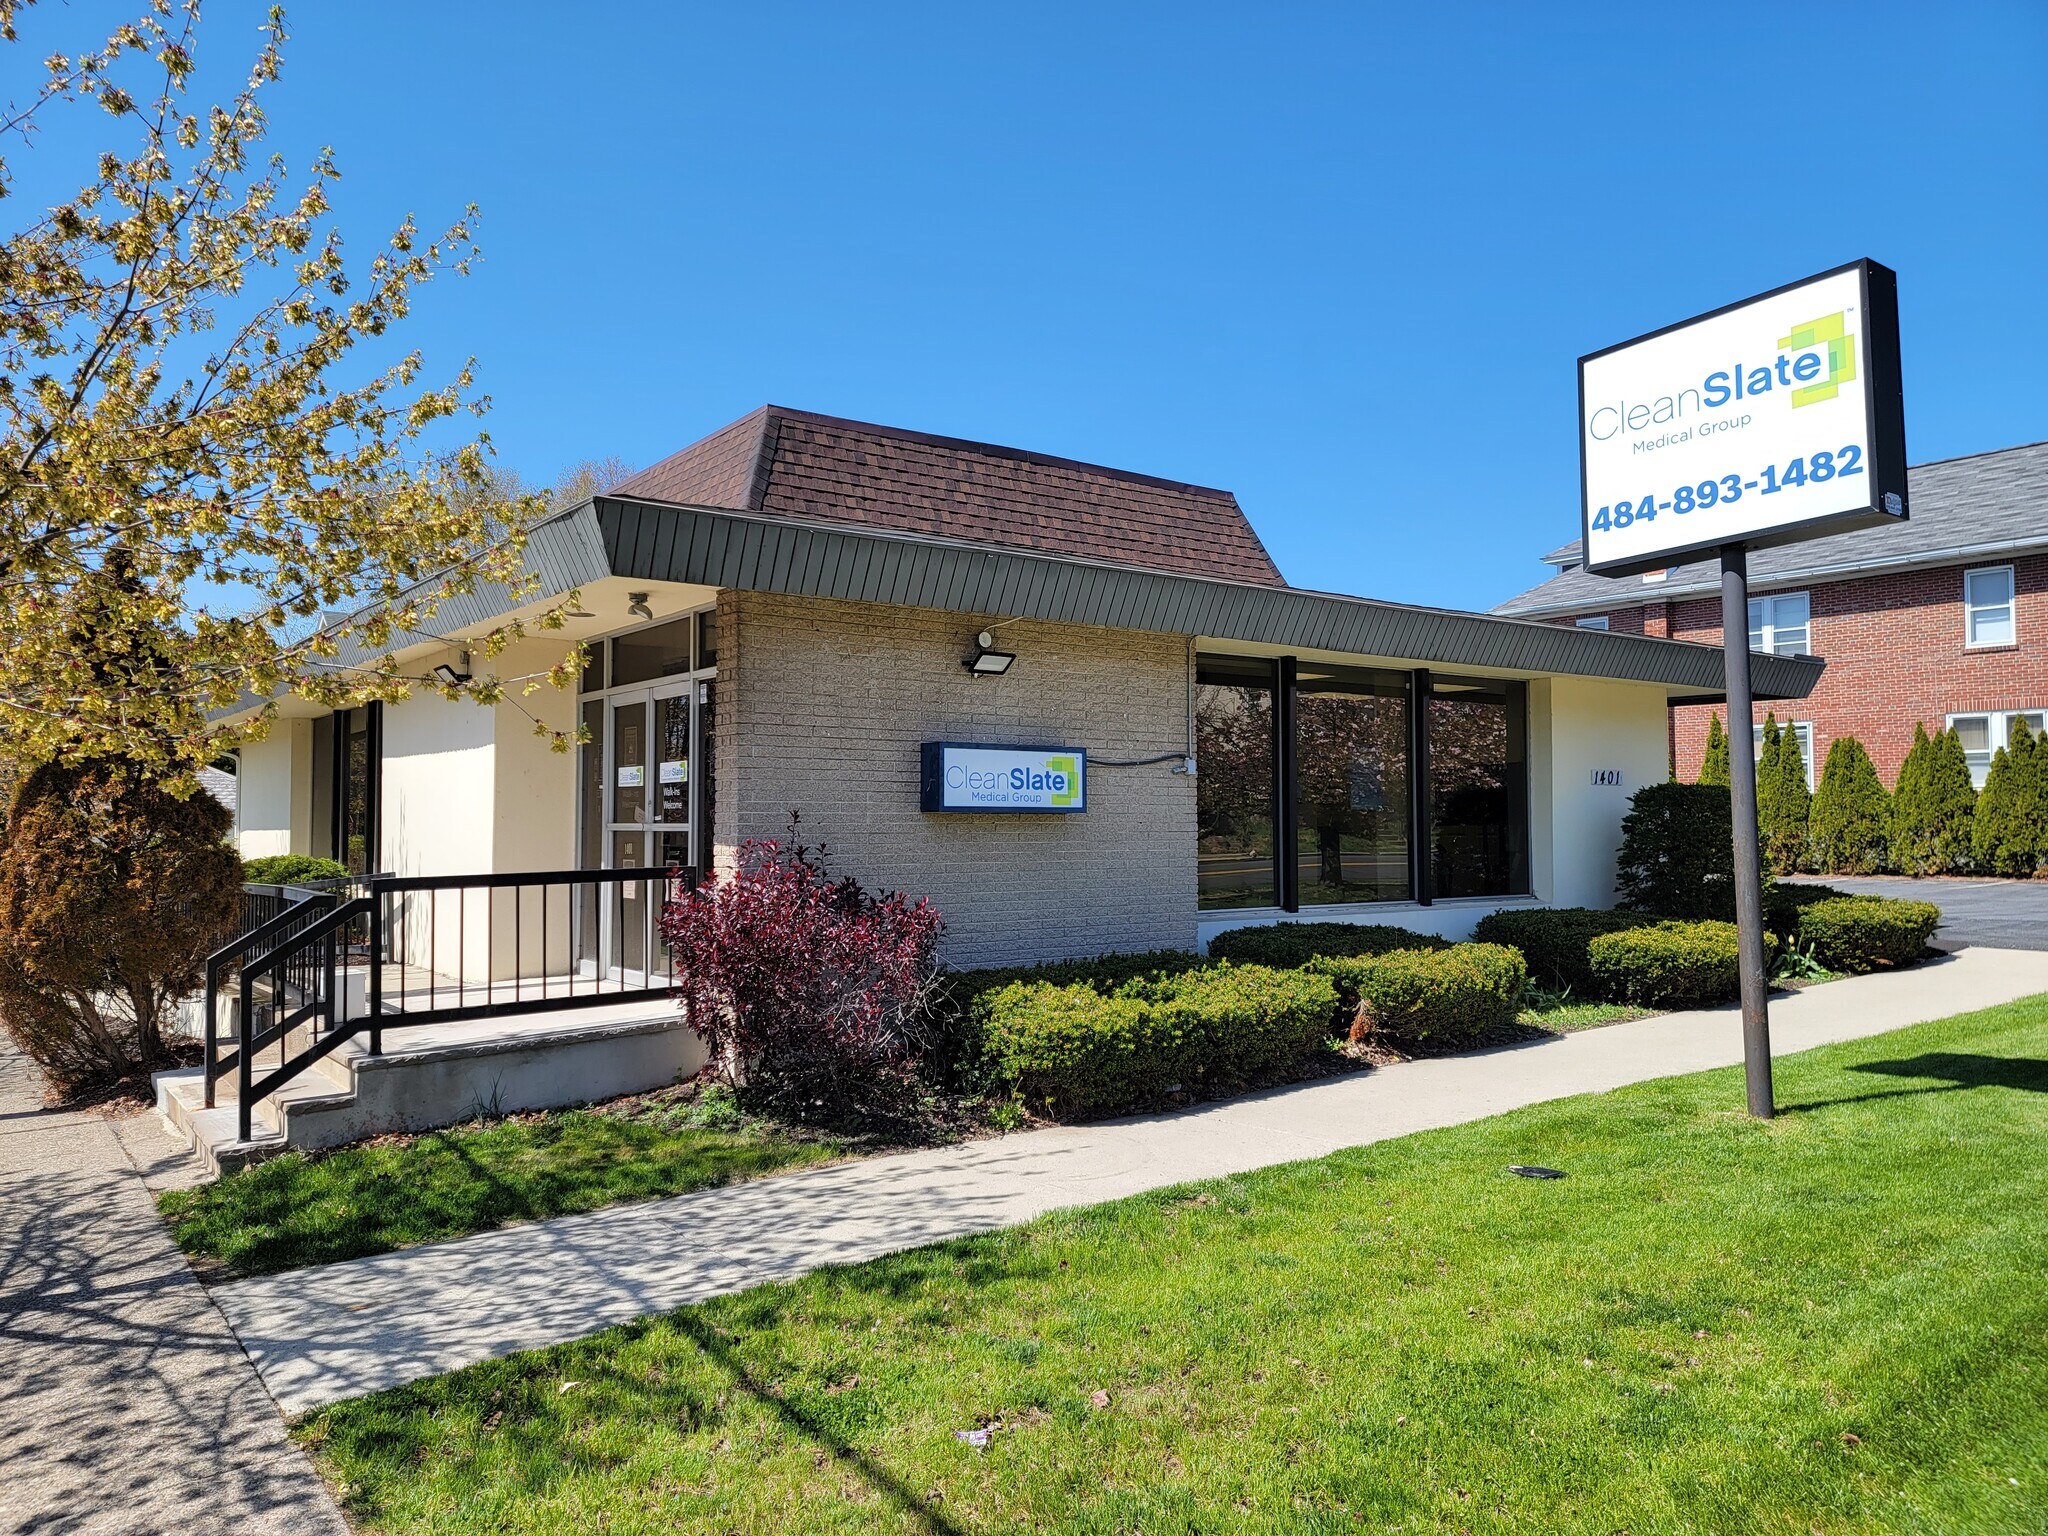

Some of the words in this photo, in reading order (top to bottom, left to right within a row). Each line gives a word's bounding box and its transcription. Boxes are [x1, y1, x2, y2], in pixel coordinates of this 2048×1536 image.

[1590, 351, 1821, 441] CleanSlate
[1632, 427, 1693, 455] Medical
[1699, 413, 1752, 437] Group
[1591, 445, 1864, 533] 484-893-1482
[946, 765, 1065, 791] CleanSlate
[1594, 770, 1620, 785] 1401
[663, 800, 683, 810] Welcome
[971, 792, 1009, 802] Medical
[1012, 792, 1042, 804] Group
